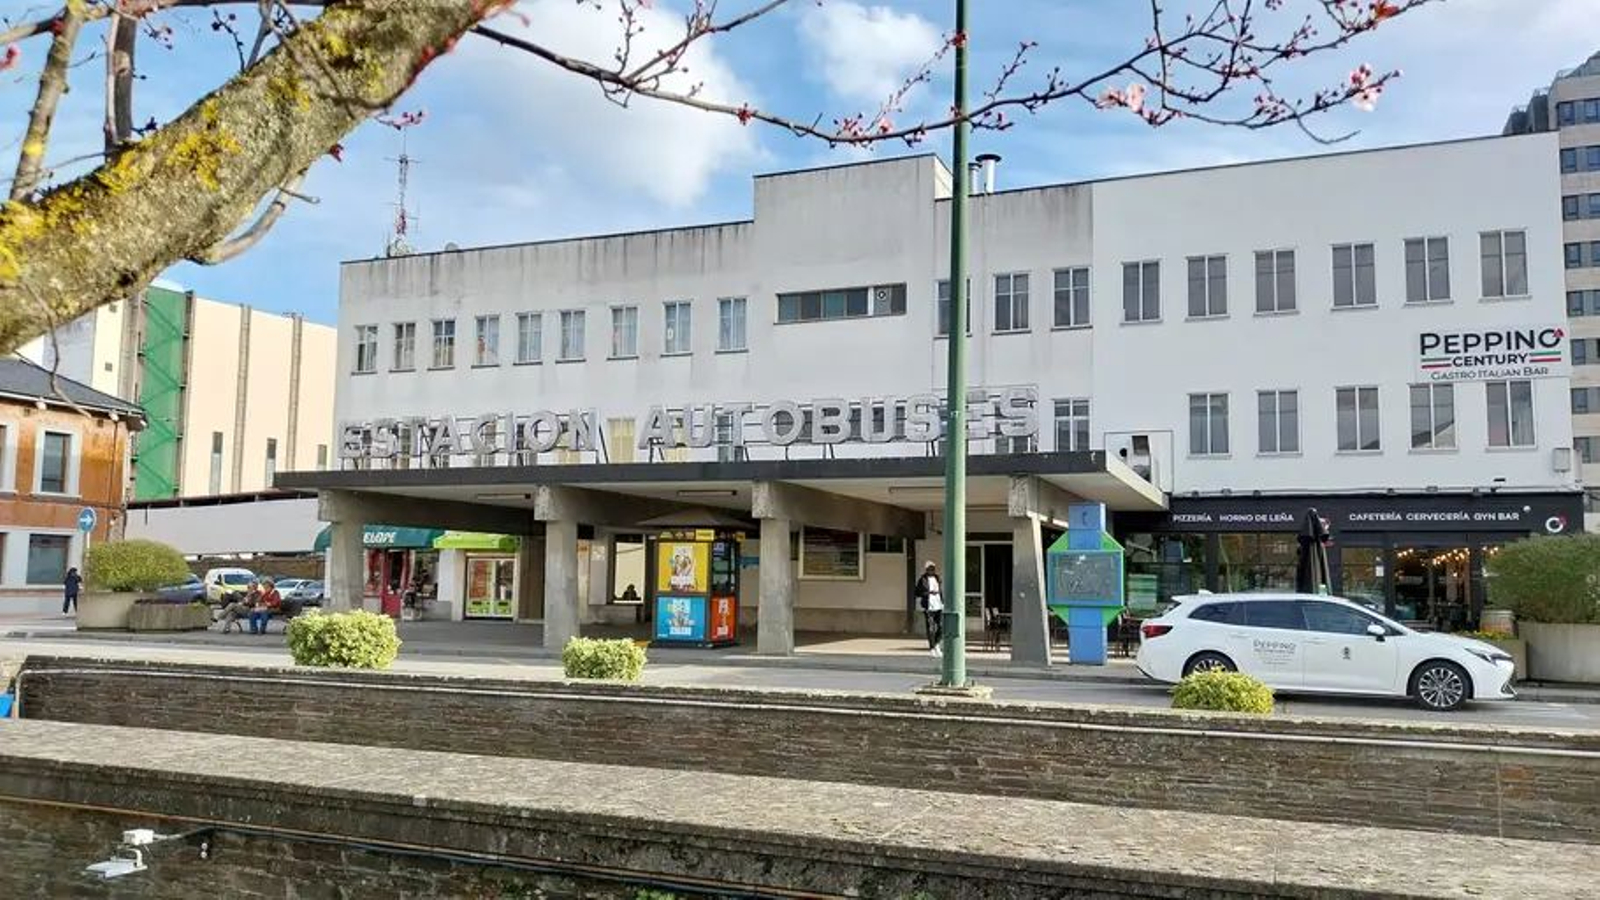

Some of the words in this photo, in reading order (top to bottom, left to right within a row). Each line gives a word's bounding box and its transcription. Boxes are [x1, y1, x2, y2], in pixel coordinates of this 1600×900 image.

[1420, 328, 1562, 355] PEPPINO
[1452, 353, 1528, 368] CENTURY
[1430, 370, 1476, 381] GASTRO
[1478, 368, 1521, 379] ITALIAN
[1523, 366, 1549, 377] BAR
[338, 407, 599, 459] ESTACION
[638, 388, 1039, 450] AUTOBUSES
[1172, 512, 1213, 523] PIZZERÍA
[1219, 513, 1254, 523] HORNO
[1254, 513, 1268, 522] DE
[1269, 511, 1295, 522] LEÑA
[1349, 511, 1402, 521] CAFETERÍA
[1406, 511, 1470, 521] CERVECERÍA
[1498, 512, 1520, 521] BAR
